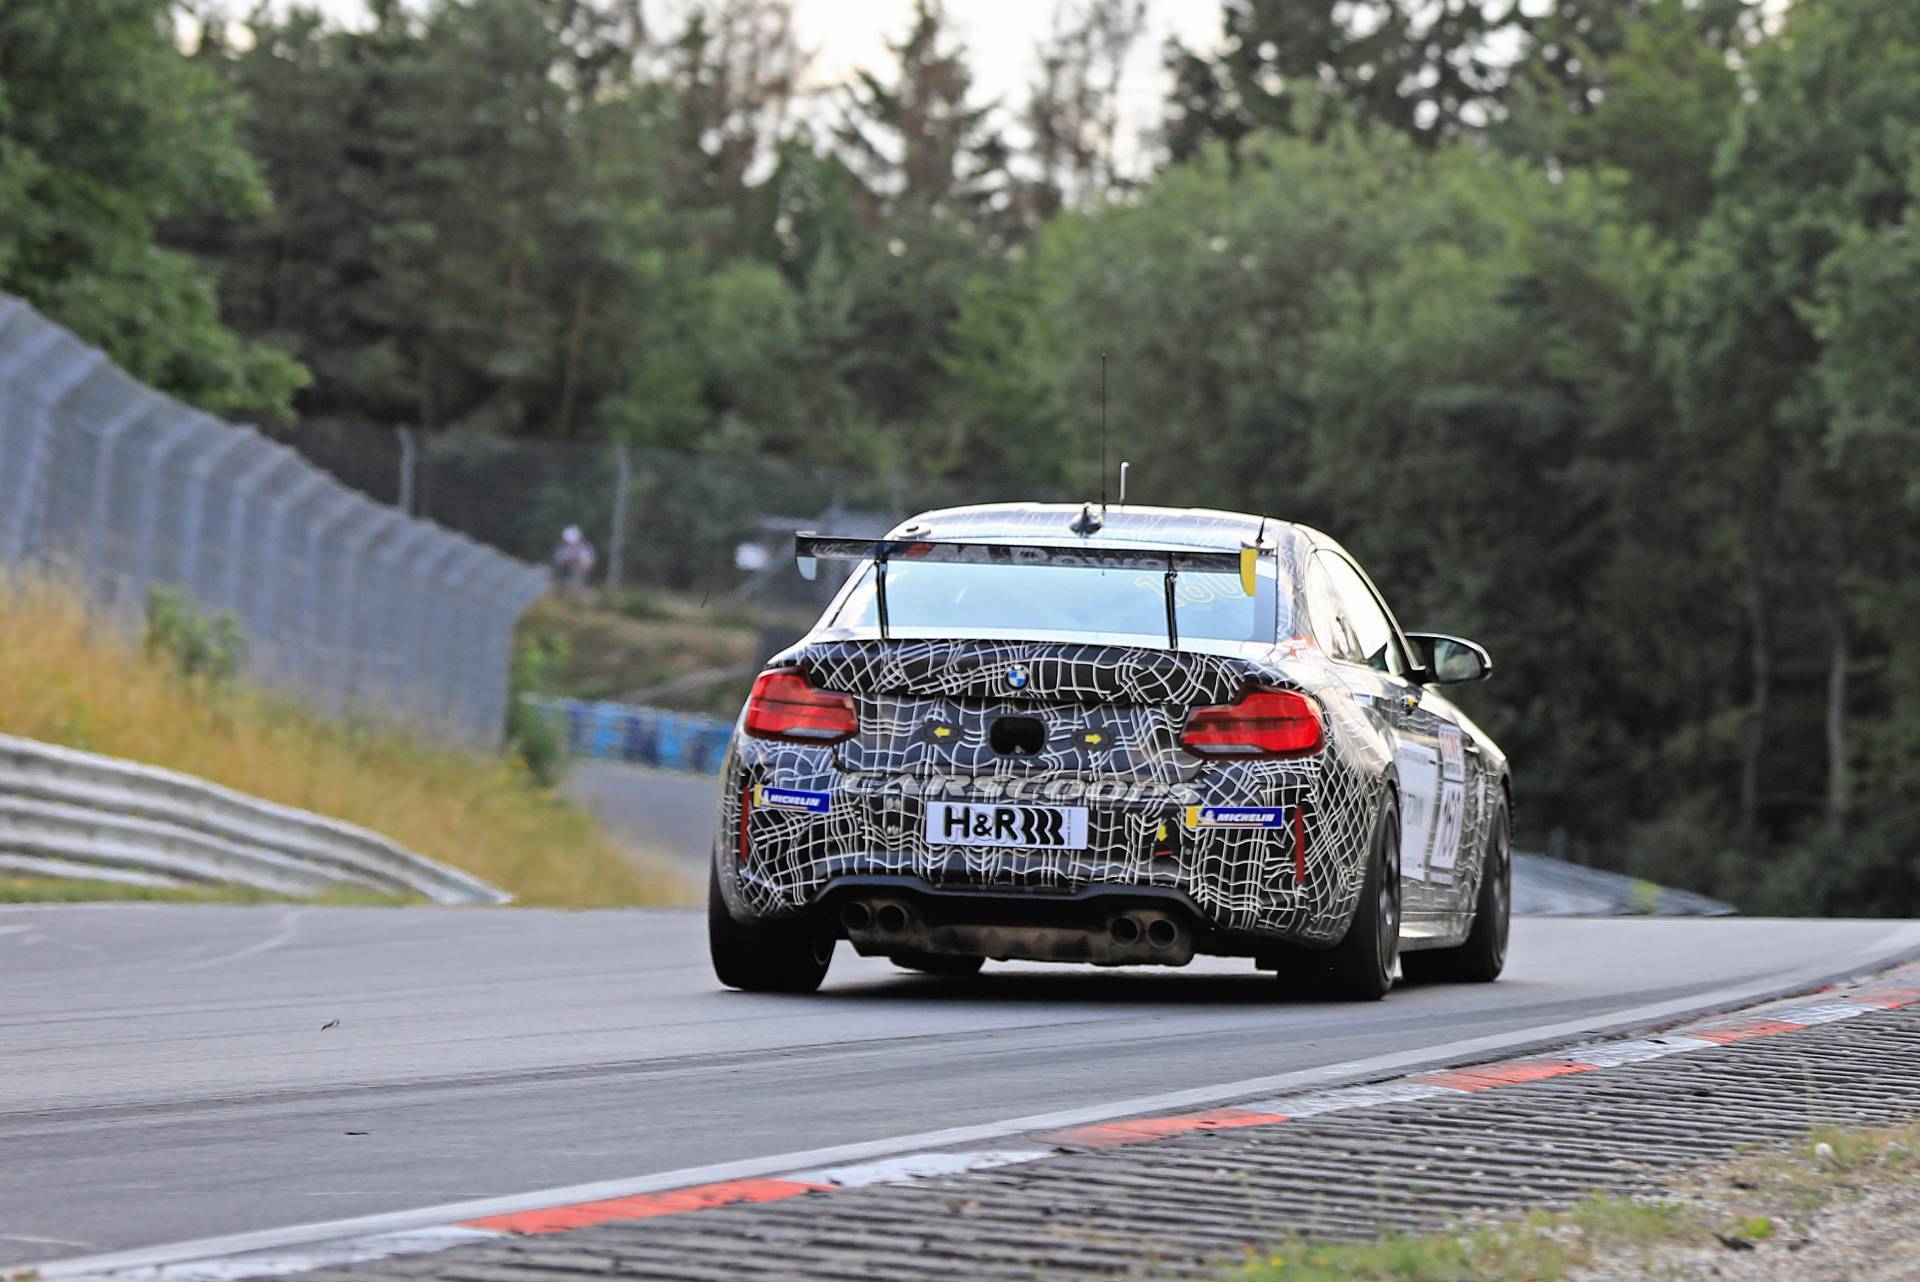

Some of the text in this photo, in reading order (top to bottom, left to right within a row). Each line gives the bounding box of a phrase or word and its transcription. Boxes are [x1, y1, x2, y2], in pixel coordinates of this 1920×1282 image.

[769, 793, 821, 807] MICHELIN
[944, 804, 1022, 843] H&R
[1216, 812, 1275, 823] MICHELIN
